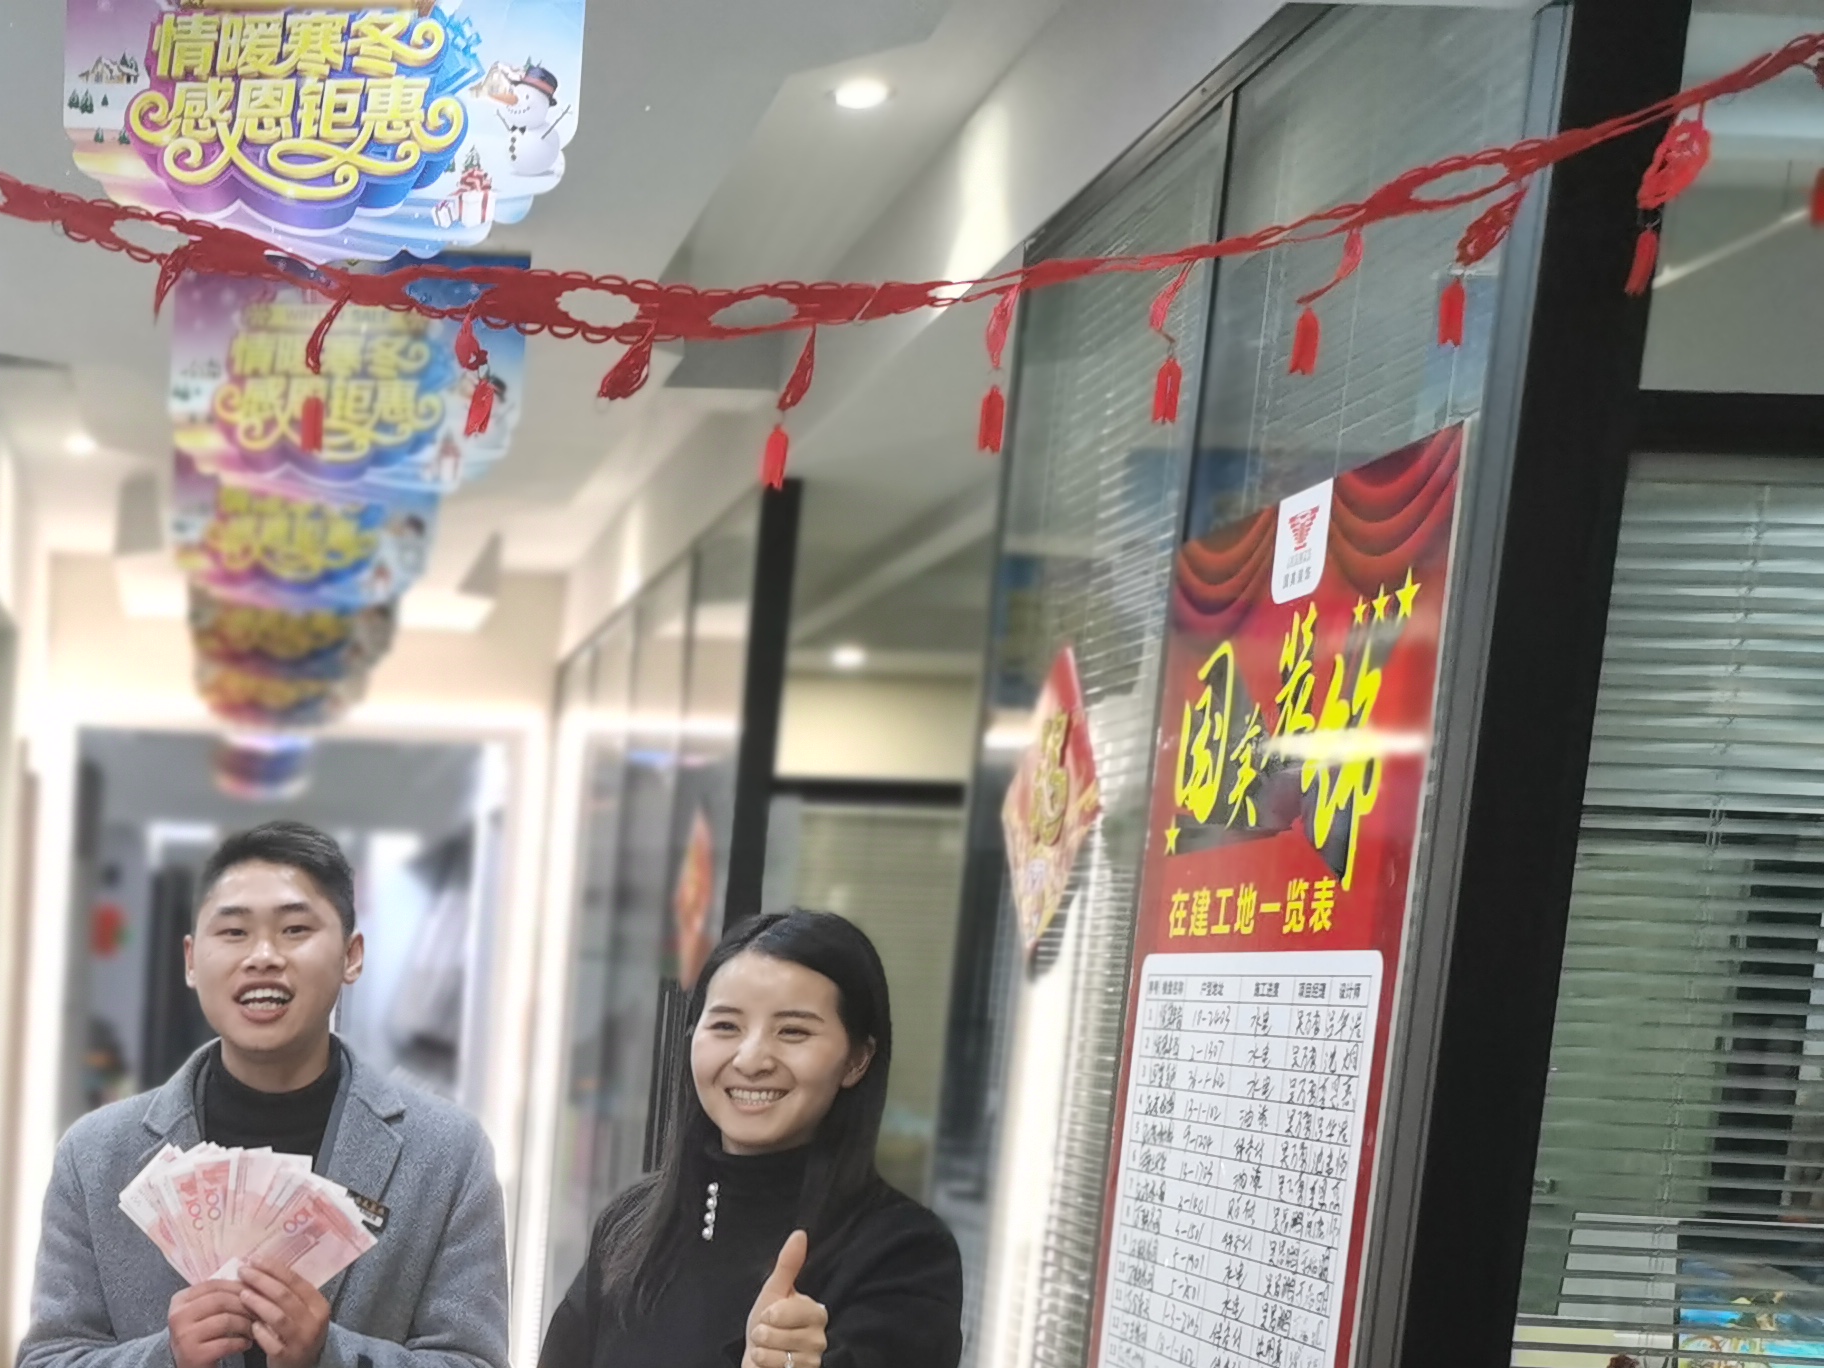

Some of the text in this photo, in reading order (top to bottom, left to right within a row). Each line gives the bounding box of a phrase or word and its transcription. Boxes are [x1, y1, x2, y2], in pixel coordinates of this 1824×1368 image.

[152, 11, 444, 79] 情暖寒冬
[127, 77, 467, 150] 感恩钜惠
[1168, 876, 1336, 938] 在建工地一览表
